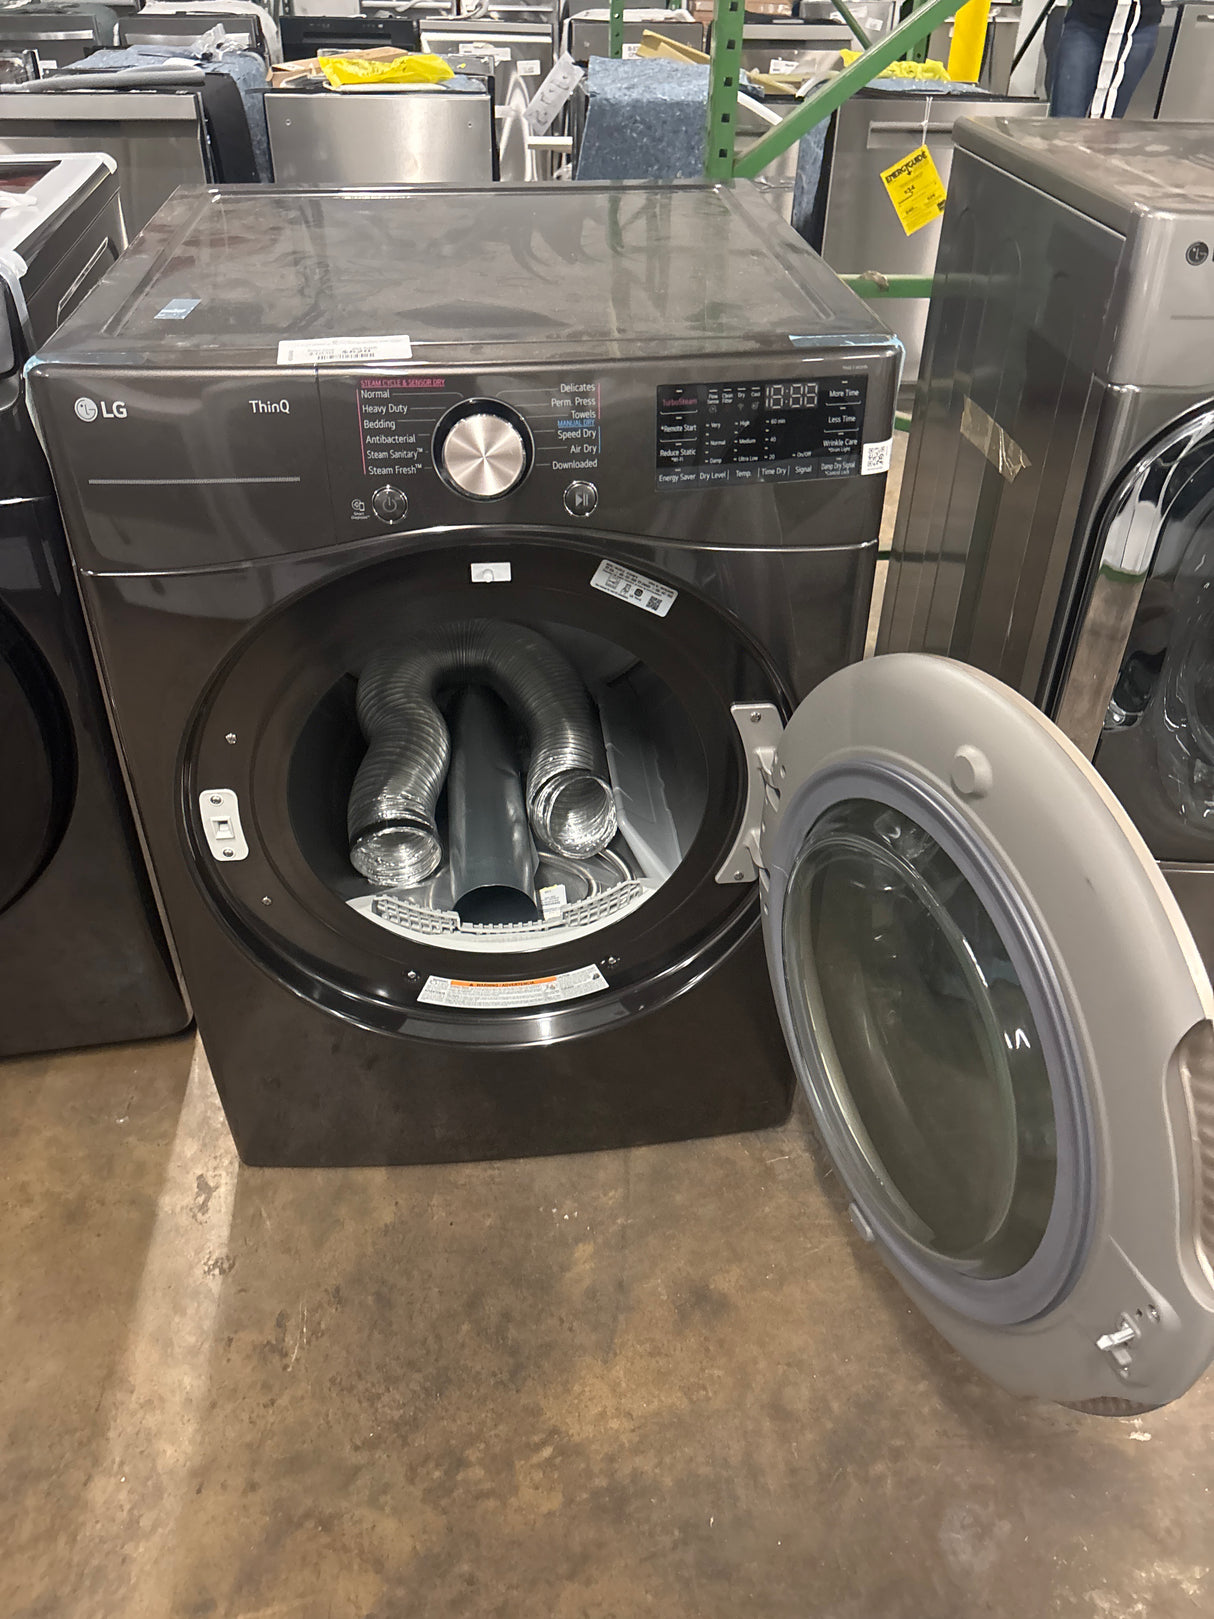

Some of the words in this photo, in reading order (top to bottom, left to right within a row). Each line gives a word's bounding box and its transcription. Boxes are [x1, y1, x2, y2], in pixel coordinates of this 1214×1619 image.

[360, 379, 381, 387] STEAM
[382, 379, 400, 387] CYCLE
[402, 379, 407, 387] &
[408, 379, 432, 387] SENSOR
[433, 378, 445, 387] DRY
[560, 382, 596, 393] Delicates
[360, 389, 390, 399] Normal
[829, 390, 844, 398] More
[249, 399, 290, 414] ThinQ
[551, 398, 573, 408] Perm.
[574, 397, 596, 407] Press
[100, 400, 128, 419] LG
[362, 404, 387, 415] Heavy
[388, 403, 408, 415] Duty
[571, 410, 596, 419] Towels
[363, 419, 396, 431] Bedding
[557, 419, 582, 427] MANUAL
[739, 420, 750, 428] High
[828, 416, 841, 424] Less
[683, 424, 697, 432] Start
[365, 433, 416, 444] Antibacterial
[557, 430, 580, 440] Speed
[580, 429, 597, 440] Dry
[823, 439, 844, 447] Wrinkle
[844, 438, 858, 446] Care
[570, 444, 583, 454] Air
[583, 444, 597, 455] Dry
[659, 449, 680, 457] Reduce
[680, 448, 697, 456] Static
[366, 450, 389, 460] Steam
[552, 458, 598, 470] Downloaded
[821, 463, 834, 471] Damp
[834, 462, 842, 471] Dry
[842, 461, 856, 469] Signal
[368, 465, 394, 475] Steam
[736, 470, 751, 478] Temp.
[762, 467, 775, 475] Time
[776, 467, 786, 476] Dry
[795, 465, 812, 474] Signal
[659, 474, 679, 483] Energy
[680, 473, 696, 481] Saver
[699, 472, 711, 481] Dry
[711, 471, 726, 479] Level
